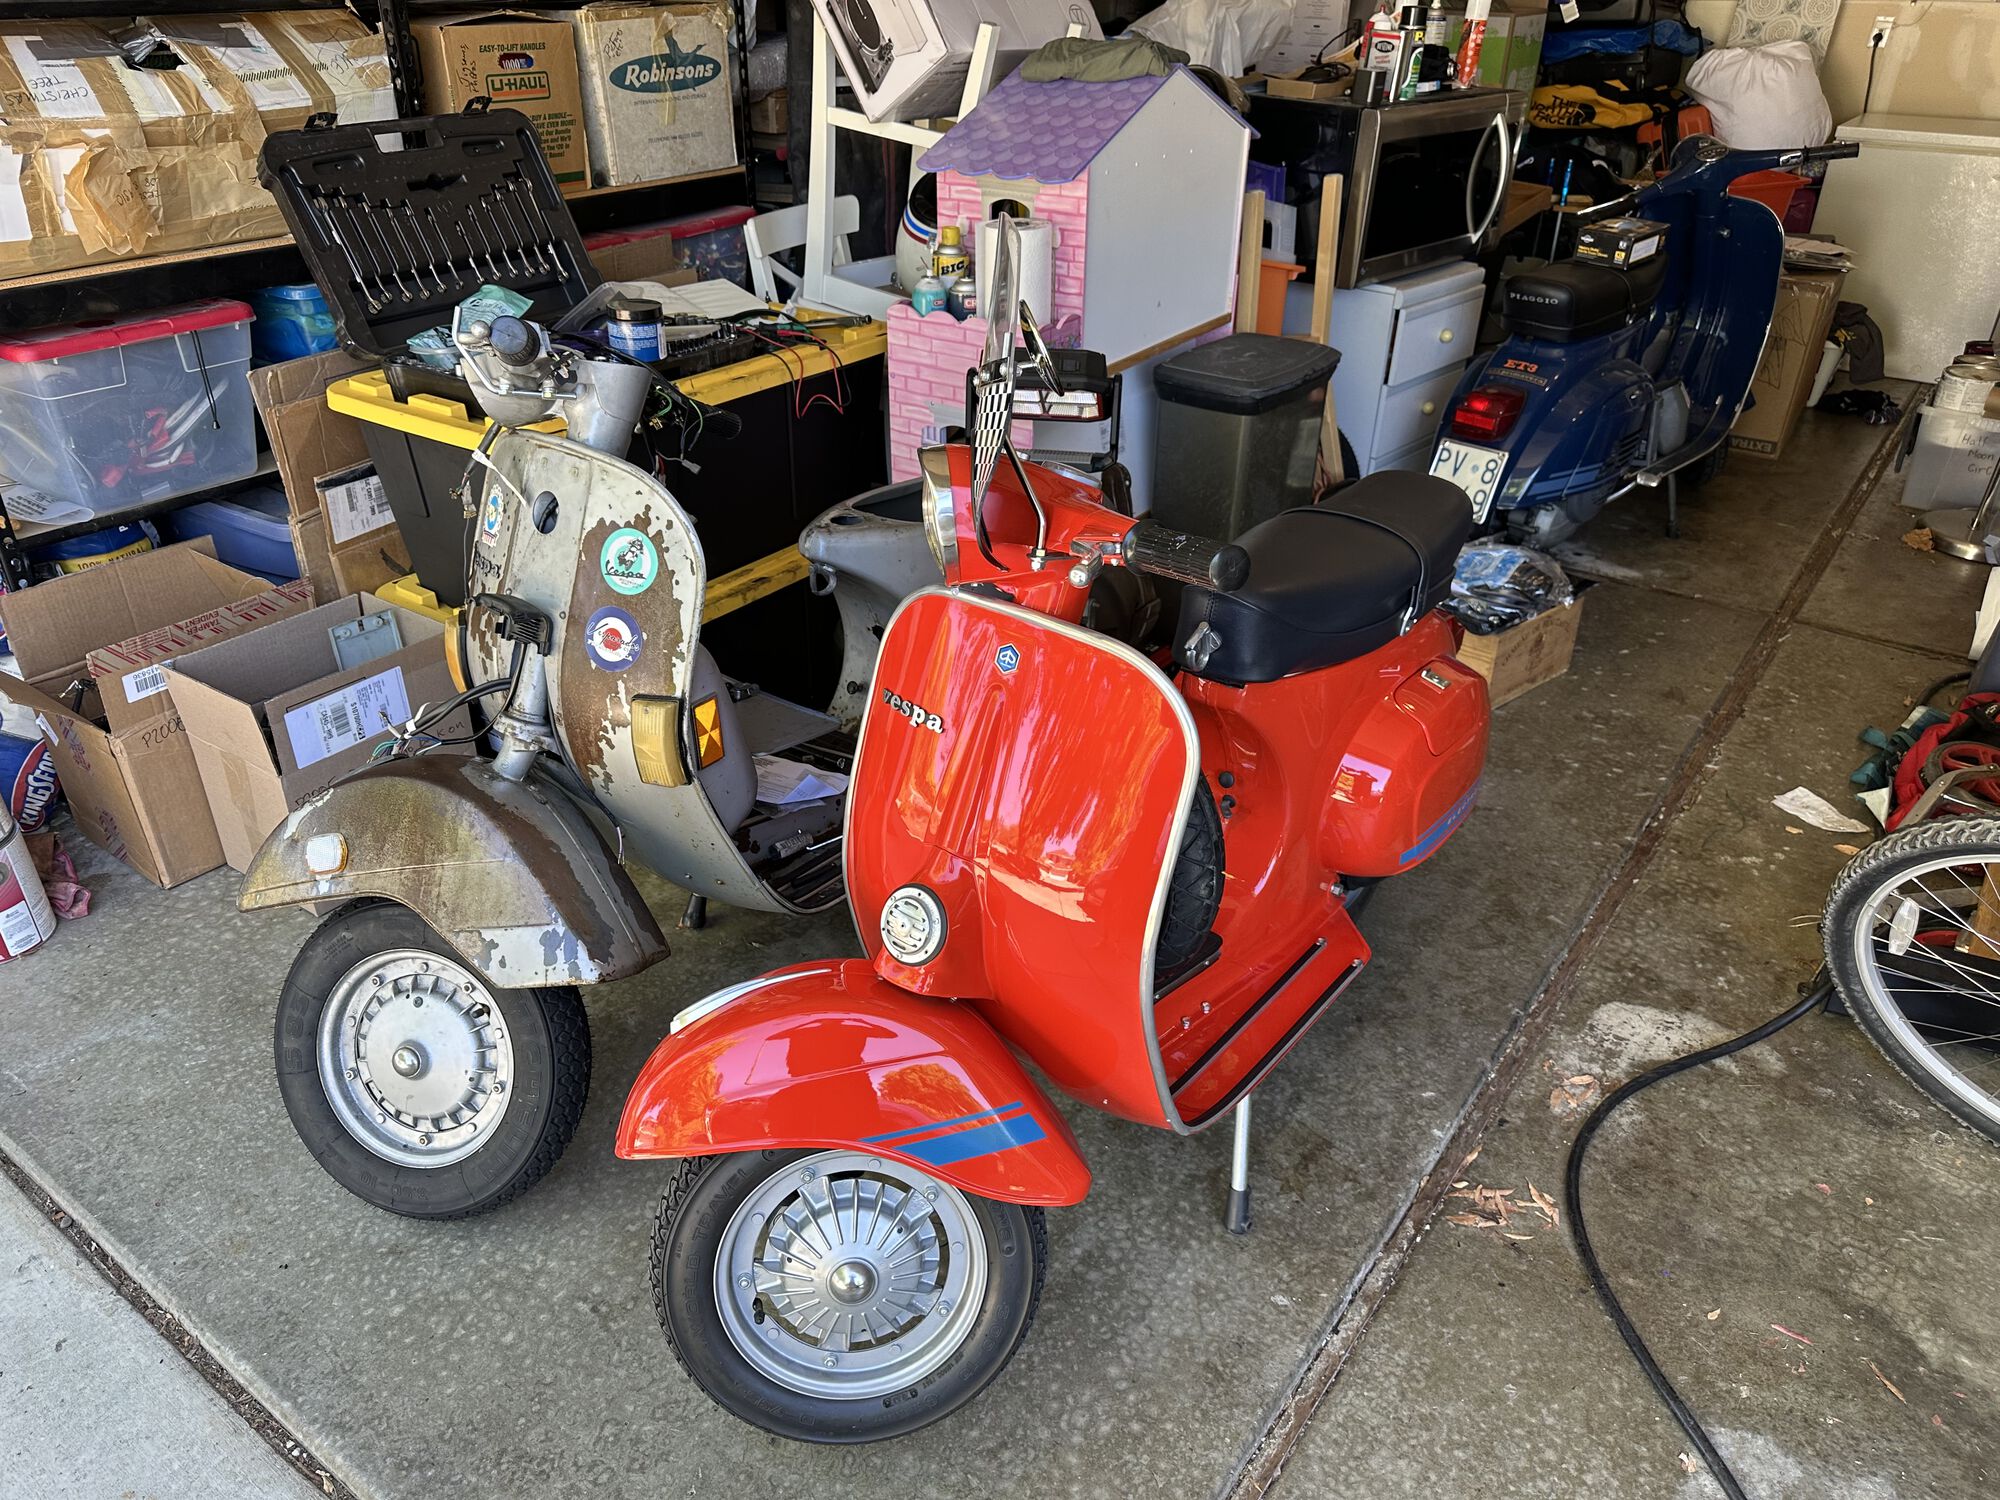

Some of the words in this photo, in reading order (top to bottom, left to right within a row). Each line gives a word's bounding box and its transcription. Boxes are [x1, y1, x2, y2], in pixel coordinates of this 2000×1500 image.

[479, 43, 519, 53] EASY-TO-LIFT
[519, 42, 546, 51] HANDLES
[28, 75, 68, 89] TREE
[624, 62, 714, 88] Robinsons
[491, 76, 547, 92] U-HAUL
[5, 86, 89, 106] CHRISTMAS
[1552, 94, 1578, 108] THE
[1533, 111, 1565, 126] FACE
[1509, 292, 1559, 305] PIAGGIO
[1503, 359, 1538, 373] ET3
[1731, 437, 1772, 453] EXTRA
[1433, 448, 1469, 477] PV
[1481, 458, 1499, 485] 8
[77, 560, 102, 571] 100%
[605, 559, 647, 579] Vespa
[184, 609, 220, 629] EVIDENT
[186, 618, 221, 636] TAMPER
[882, 688, 945, 734] vespa
[692, 1166, 751, 1242] TRAVEL
